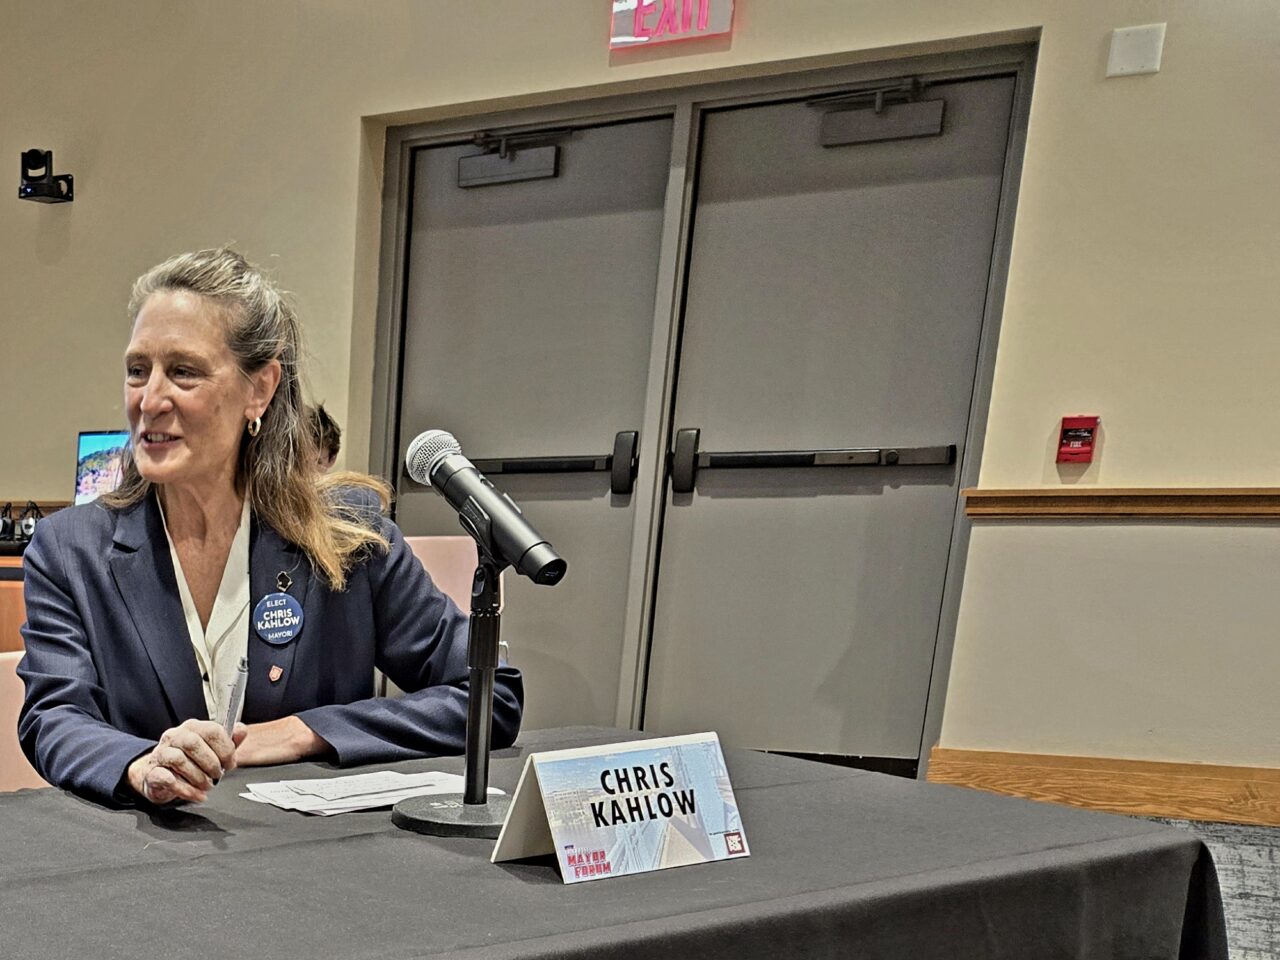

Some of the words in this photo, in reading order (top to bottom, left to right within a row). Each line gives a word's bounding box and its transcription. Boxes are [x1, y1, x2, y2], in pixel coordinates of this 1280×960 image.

[633, 0, 709, 37] EXIT
[266, 599, 287, 607] ELECT
[263, 608, 293, 620] CHRIS
[257, 616, 300, 630] KAHLOW
[600, 762, 675, 795] CHRIS
[590, 789, 696, 828] KAHLOW
[567, 850, 606, 867] MAYOR
[575, 861, 612, 878] FORUM
